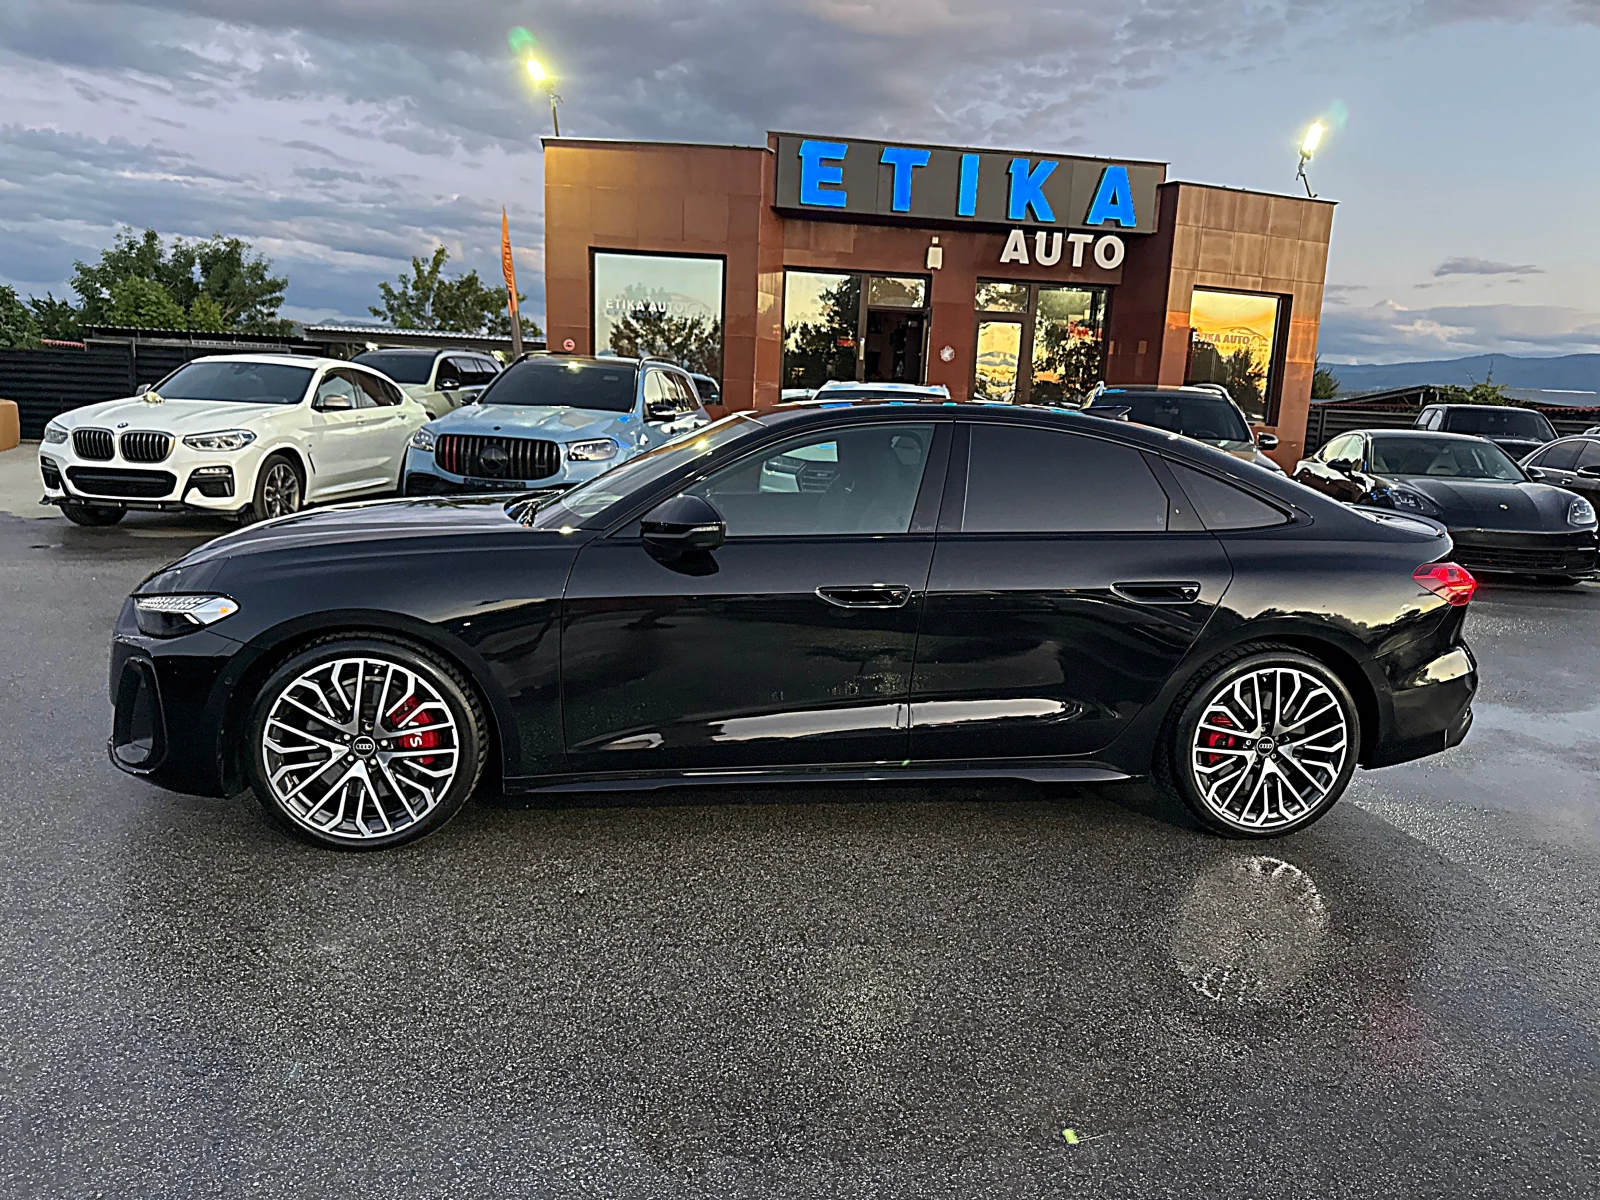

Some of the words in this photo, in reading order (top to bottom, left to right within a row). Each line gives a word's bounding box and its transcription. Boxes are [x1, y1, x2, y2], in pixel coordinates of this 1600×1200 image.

[799, 140, 1137, 227] ETIKA
[999, 229, 1126, 269] AUTO
[605, 299, 646, 312] ETIKA
[1223, 334, 1250, 345] AUTO
